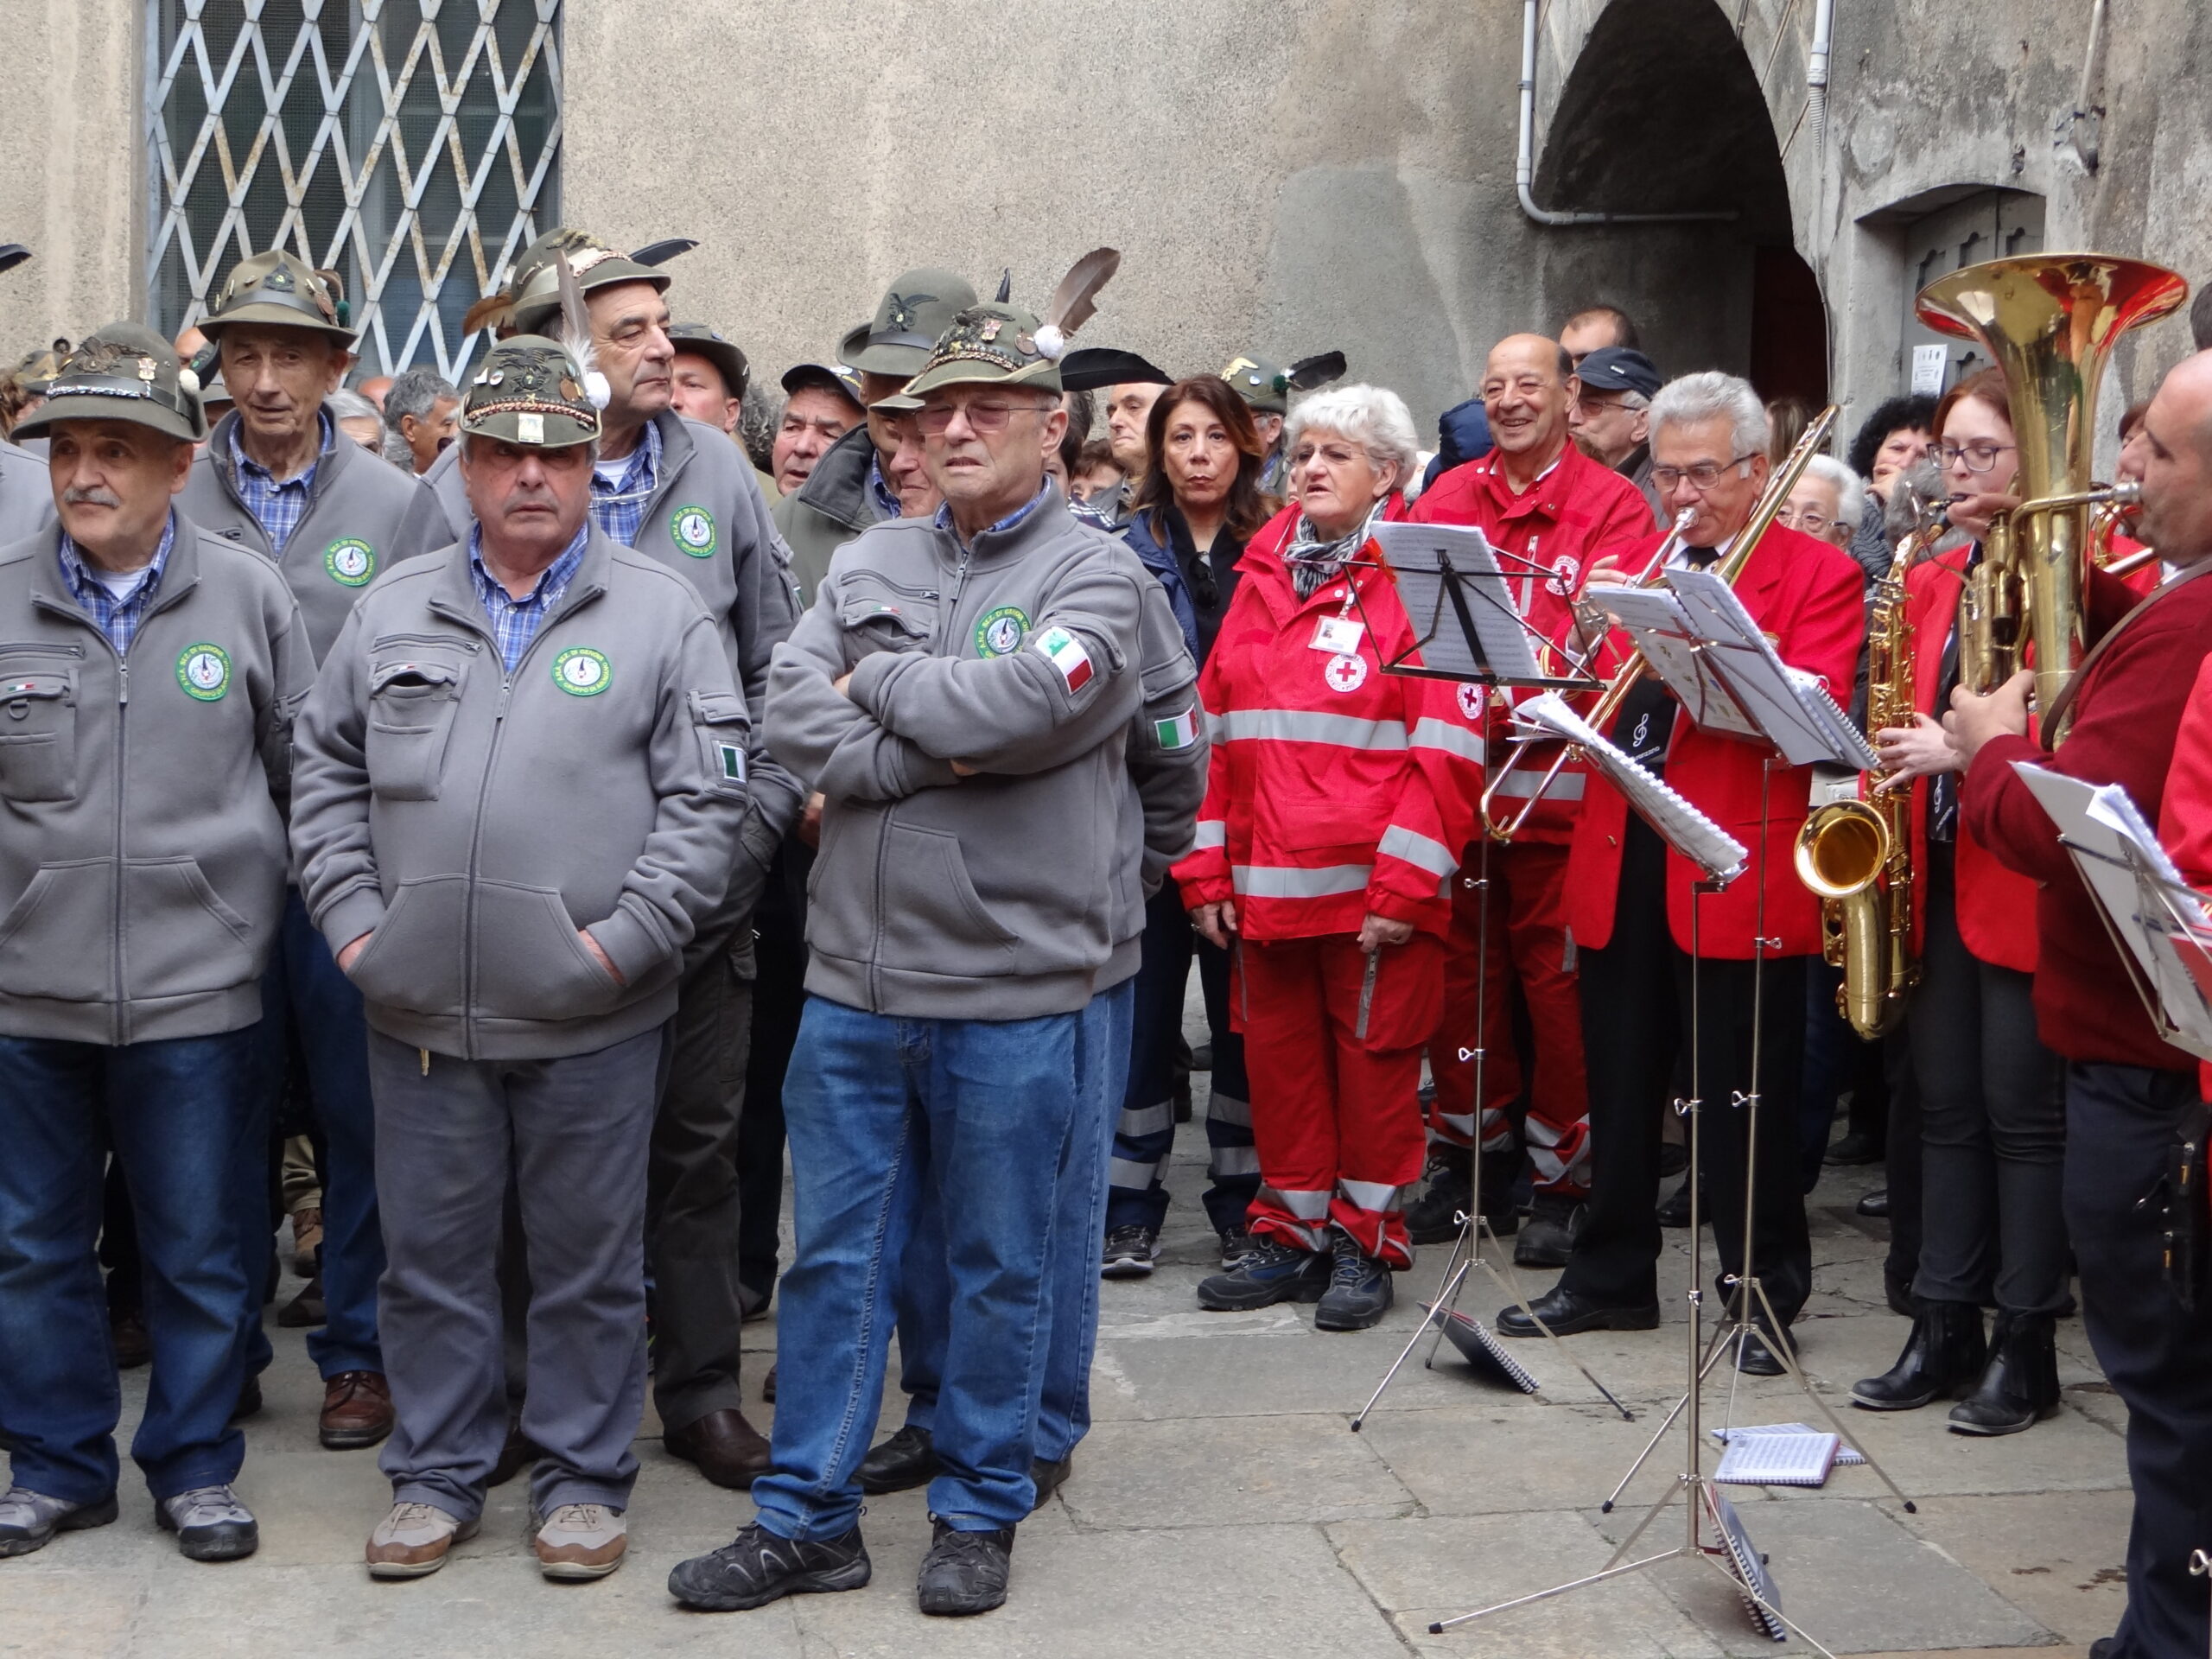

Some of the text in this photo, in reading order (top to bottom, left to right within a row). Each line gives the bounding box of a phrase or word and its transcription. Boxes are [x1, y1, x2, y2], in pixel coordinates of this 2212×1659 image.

[199, 645, 225, 657] GENOVA
[579, 649, 605, 662] GENOVA
[1635, 746, 1661, 760] renzano
